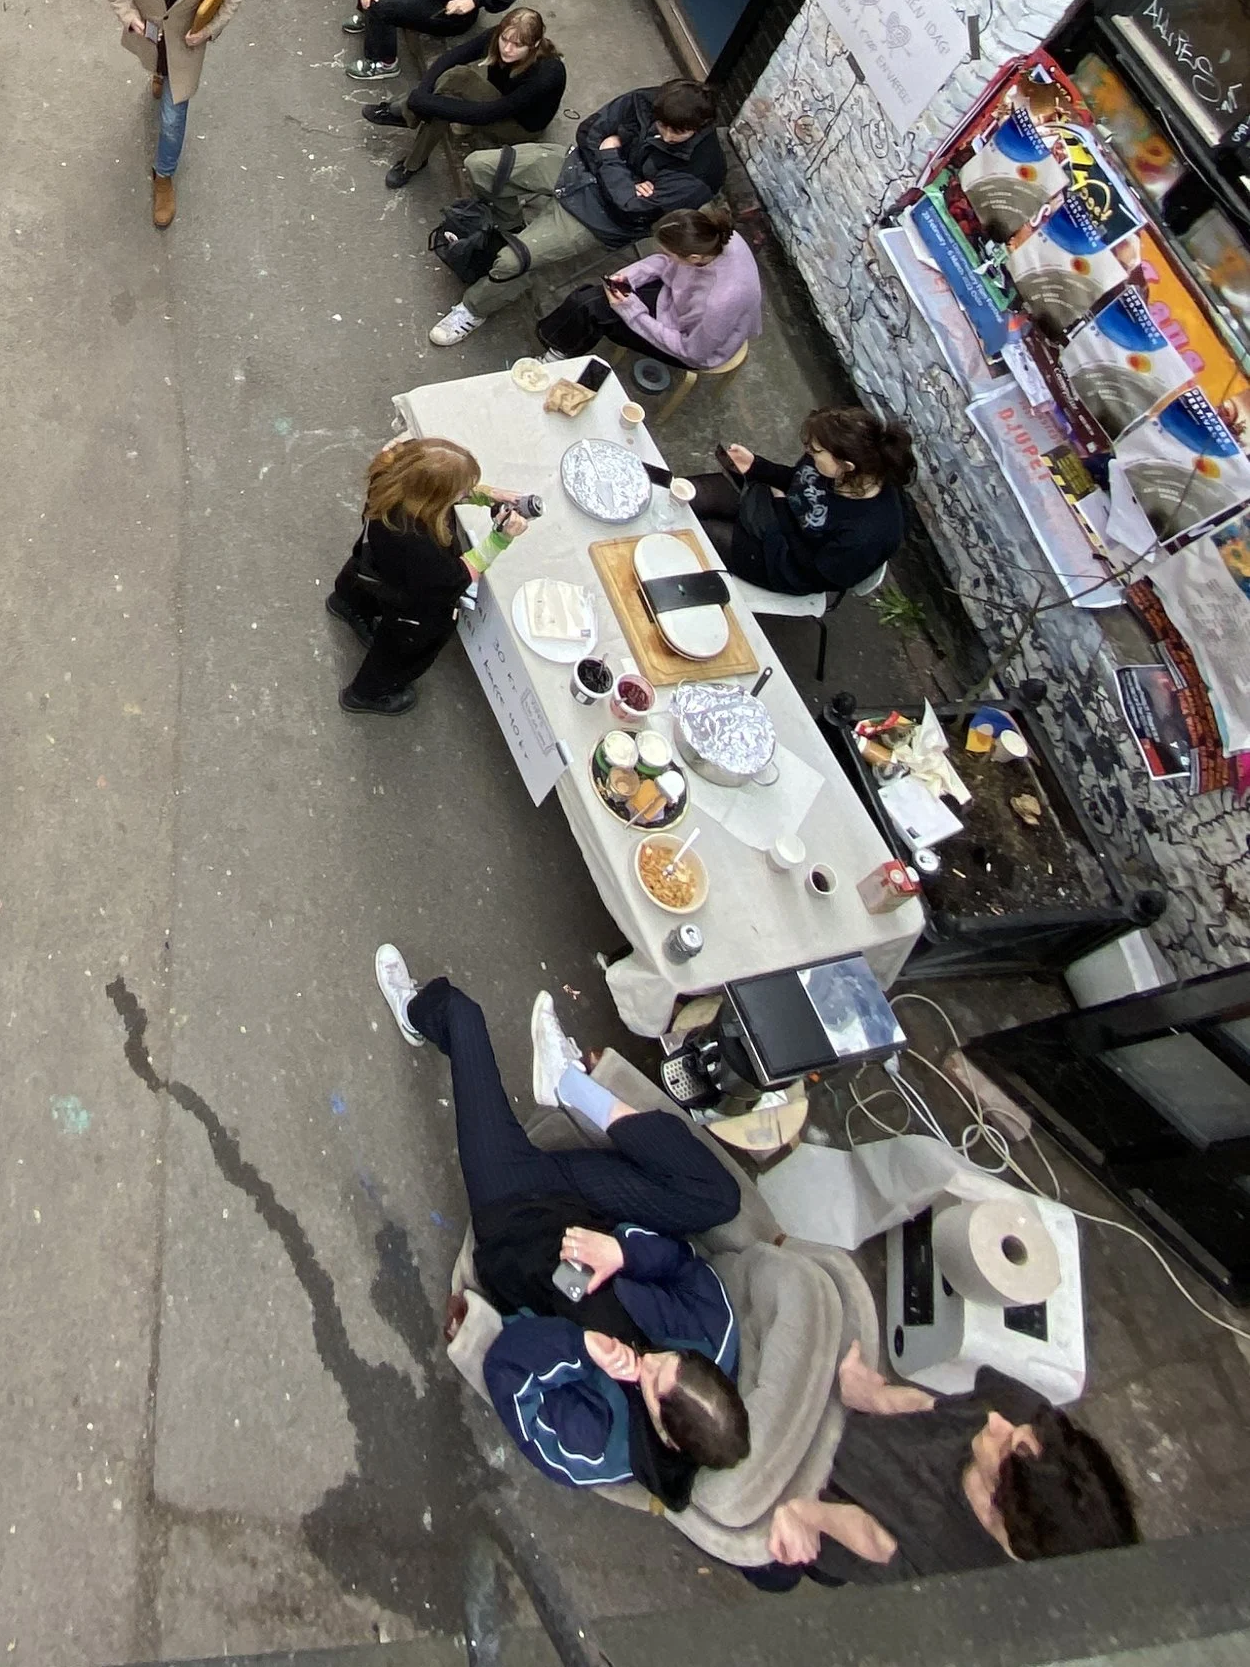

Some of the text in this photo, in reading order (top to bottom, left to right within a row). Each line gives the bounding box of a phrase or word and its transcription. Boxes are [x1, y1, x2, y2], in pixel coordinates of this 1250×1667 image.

[926, 217, 948, 248] February
[1122, 291, 1159, 345] FESTIVALEN
[1127, 288, 1142, 307] DEN
[1138, 308, 1161, 339] ANDRE
[1183, 391, 1229, 453] FESTIVALEN
[1192, 388, 1232, 446] DEN ANDRE
